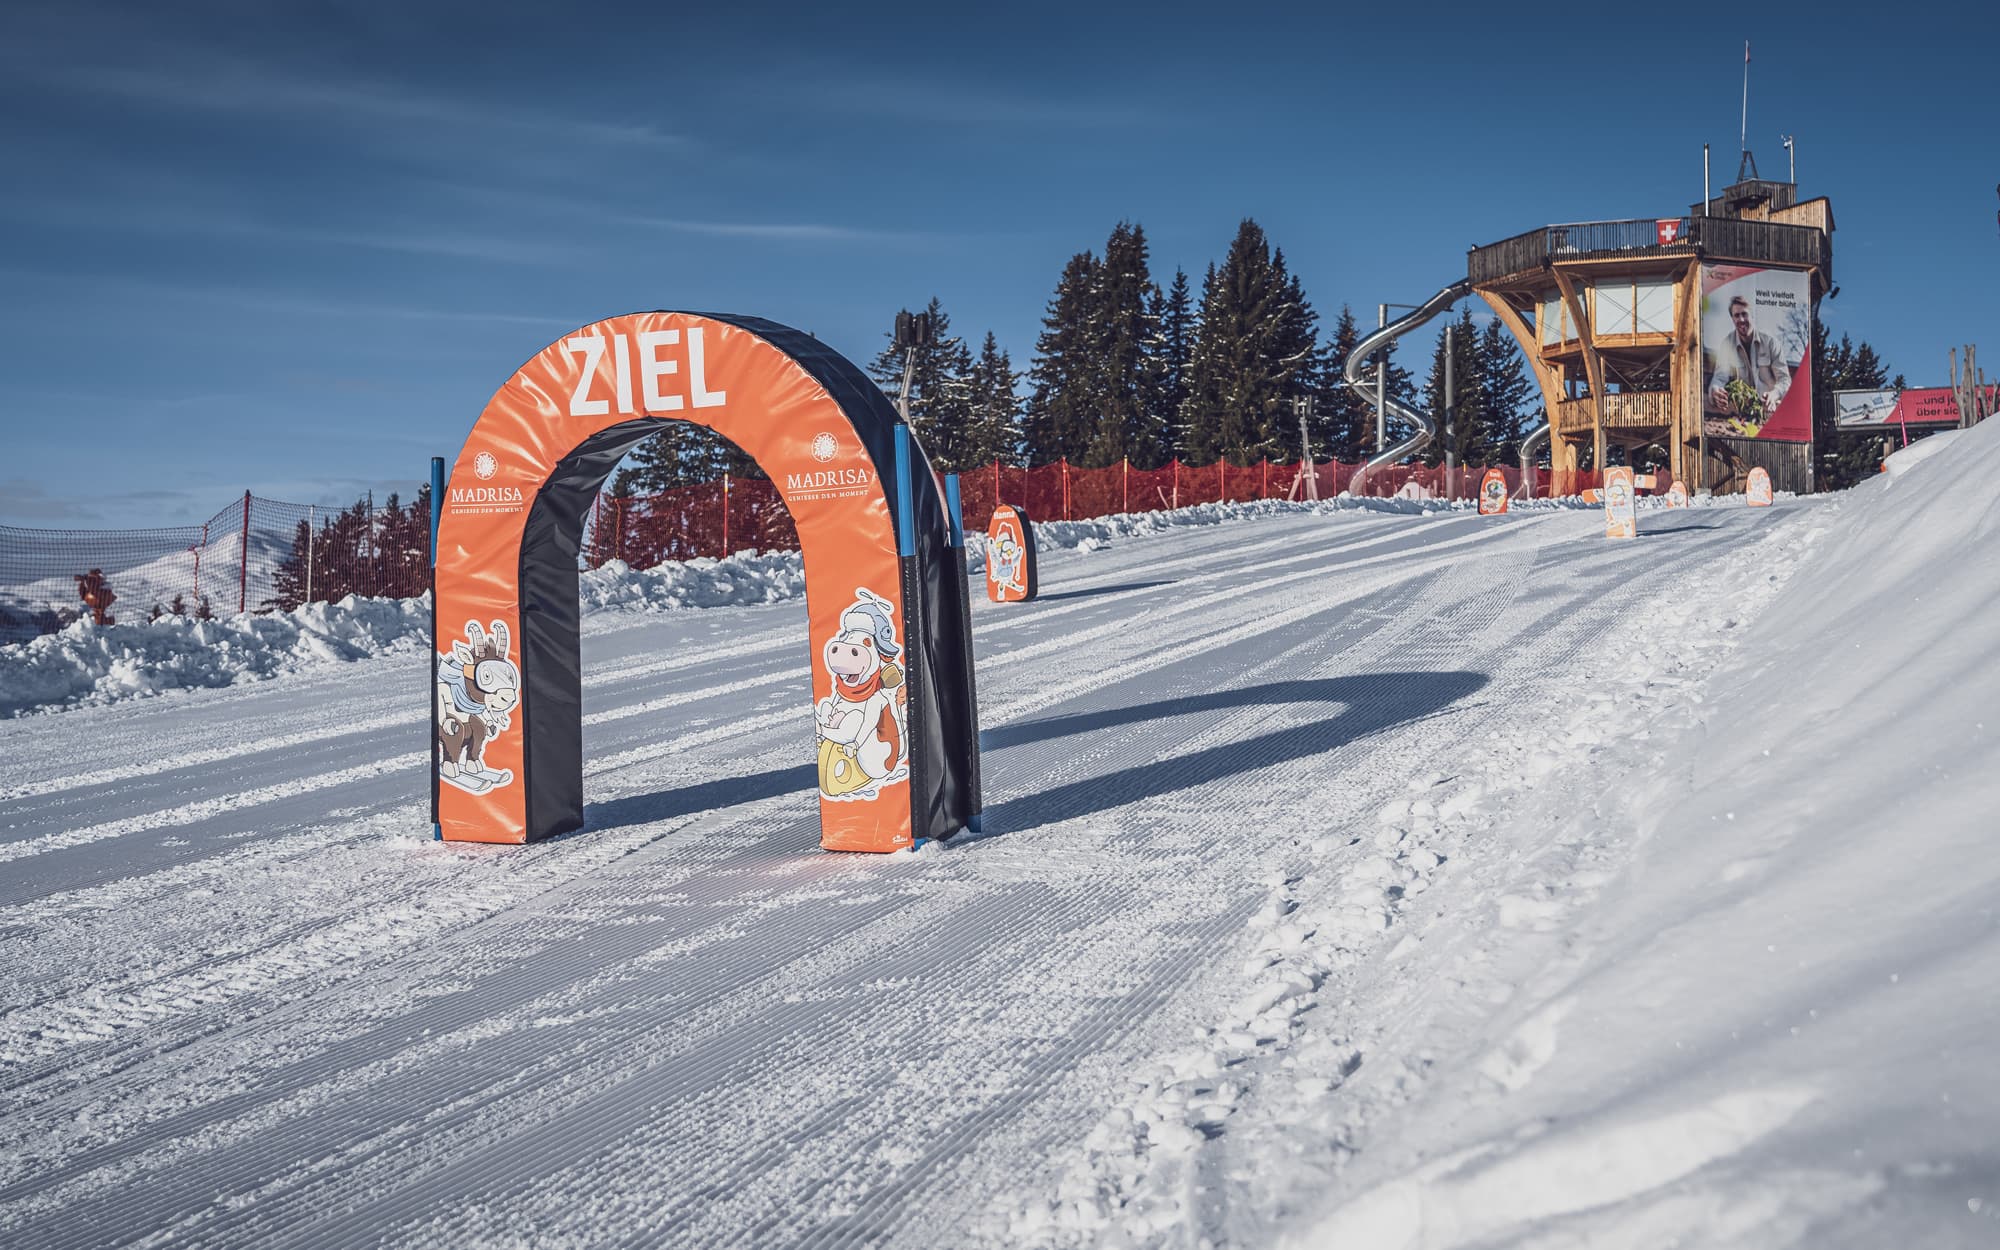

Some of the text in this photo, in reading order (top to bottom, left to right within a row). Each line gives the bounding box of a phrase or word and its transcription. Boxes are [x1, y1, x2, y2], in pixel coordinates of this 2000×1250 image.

[1755, 289, 1795, 299] Weil Vielfalt
[1755, 299, 1796, 308] bunter blüht
[567, 327, 727, 416] ZIEL
[1916, 407, 1959, 416] über sic
[787, 468, 868, 489] MADRISA
[451, 487, 523, 503] MADRISA
[788, 494, 819, 502] GENIESSE
[839, 490, 869, 498] MOMENT
